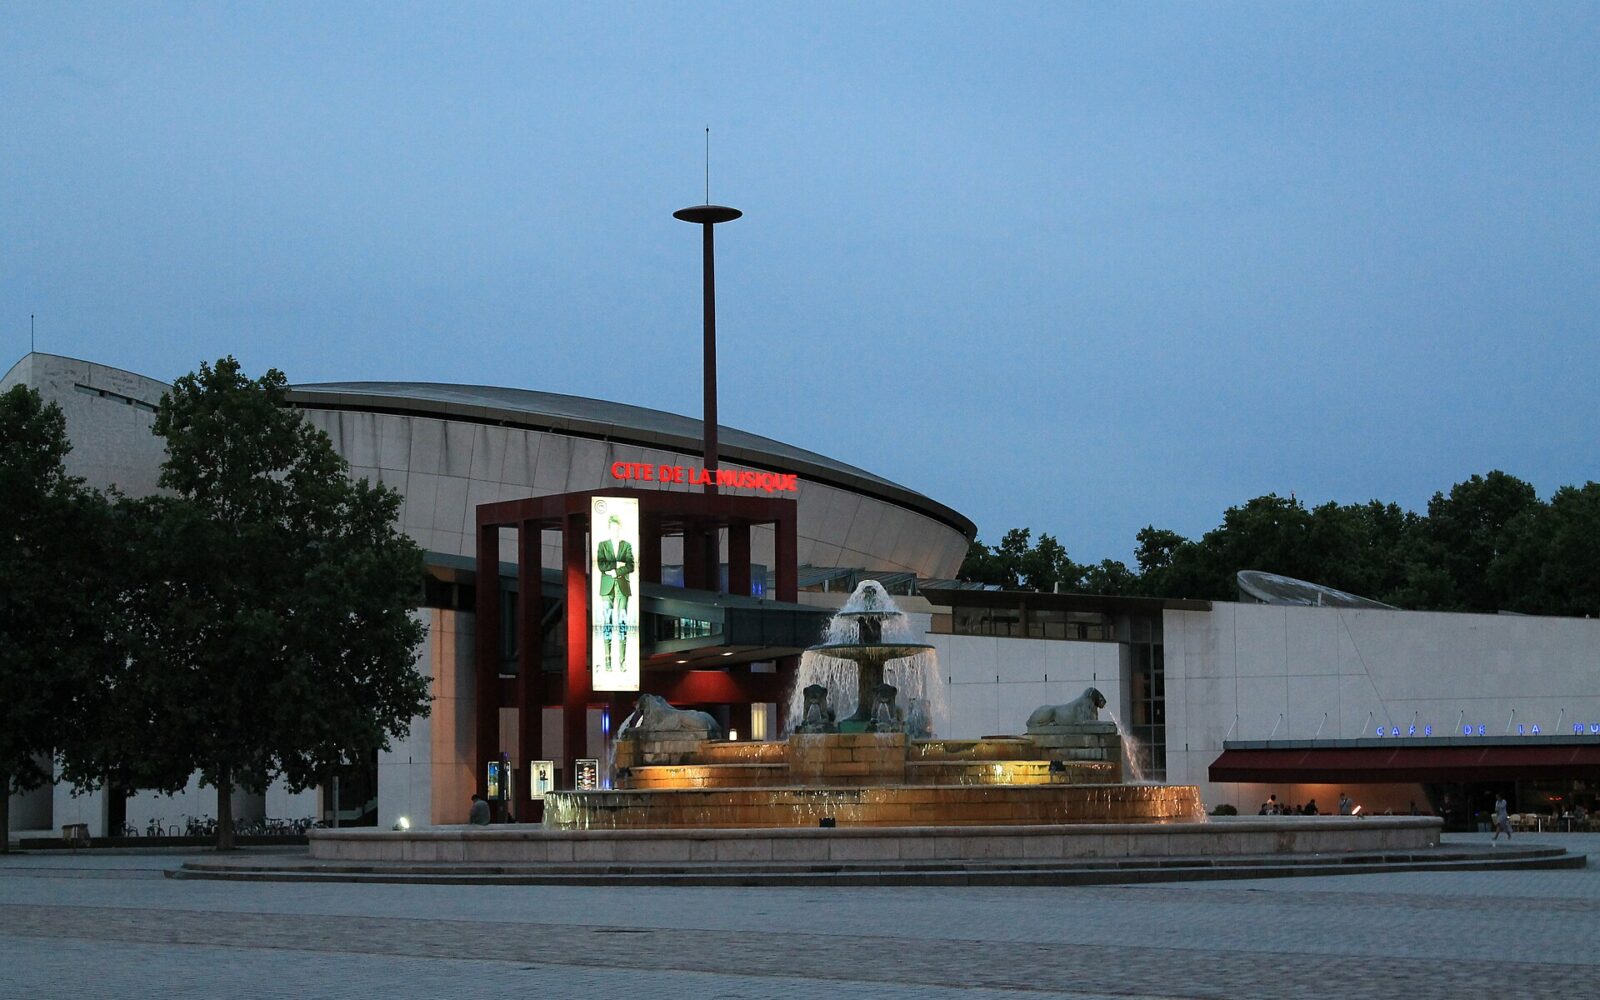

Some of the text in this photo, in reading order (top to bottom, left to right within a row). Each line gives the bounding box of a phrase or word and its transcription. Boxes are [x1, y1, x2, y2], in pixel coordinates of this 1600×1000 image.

[611, 461, 797, 493] CITE DE LA MUSIQUE
[1464, 724, 1486, 735] DE
[1519, 724, 1540, 734] LA
